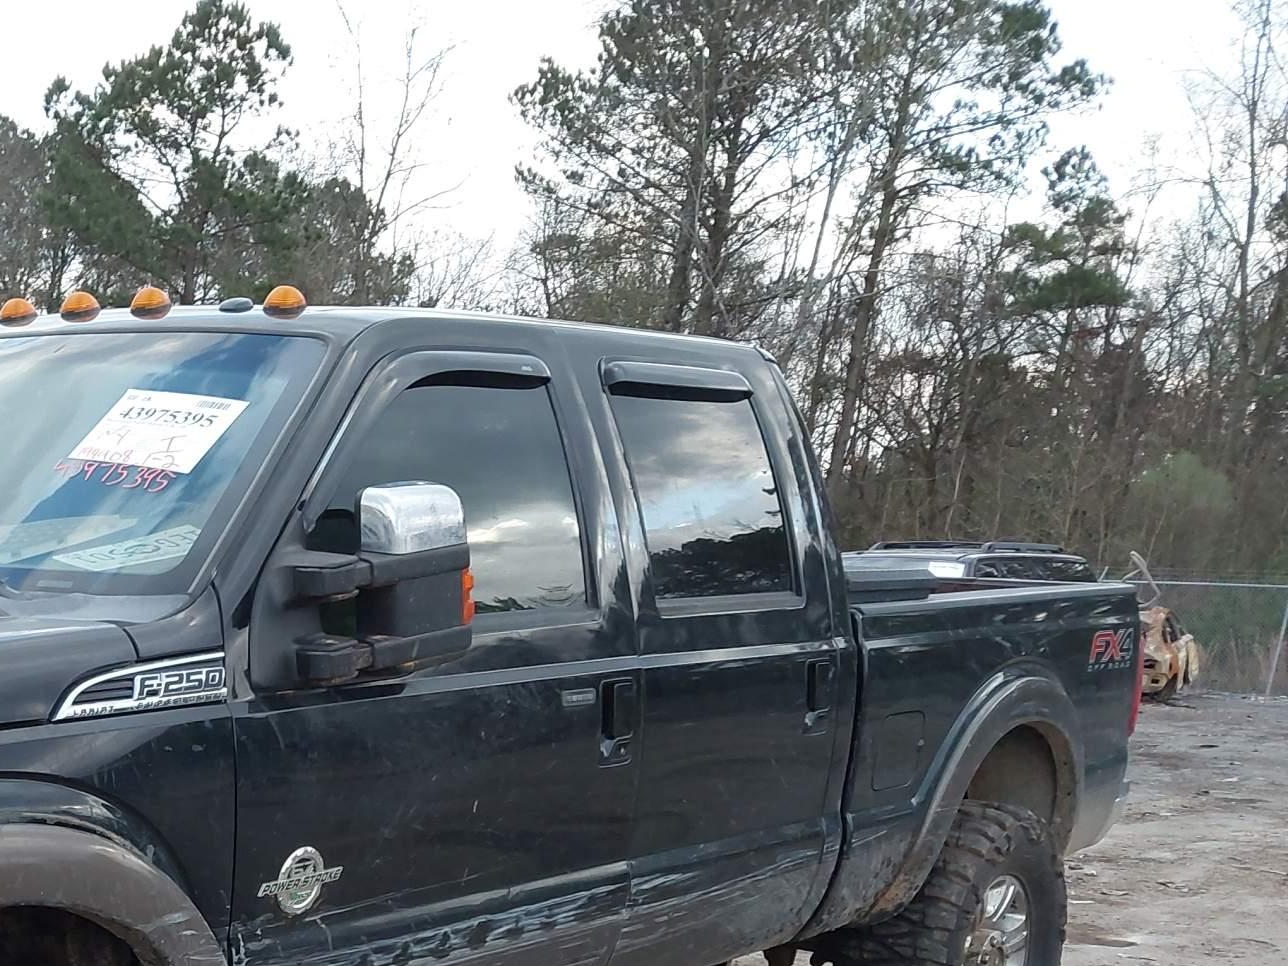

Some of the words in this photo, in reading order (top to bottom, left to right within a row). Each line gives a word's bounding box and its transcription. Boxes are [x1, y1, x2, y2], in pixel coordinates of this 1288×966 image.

[120, 405, 219, 428] 43975395
[1089, 628, 1134, 663] FX4
[136, 667, 225, 699] F-250
